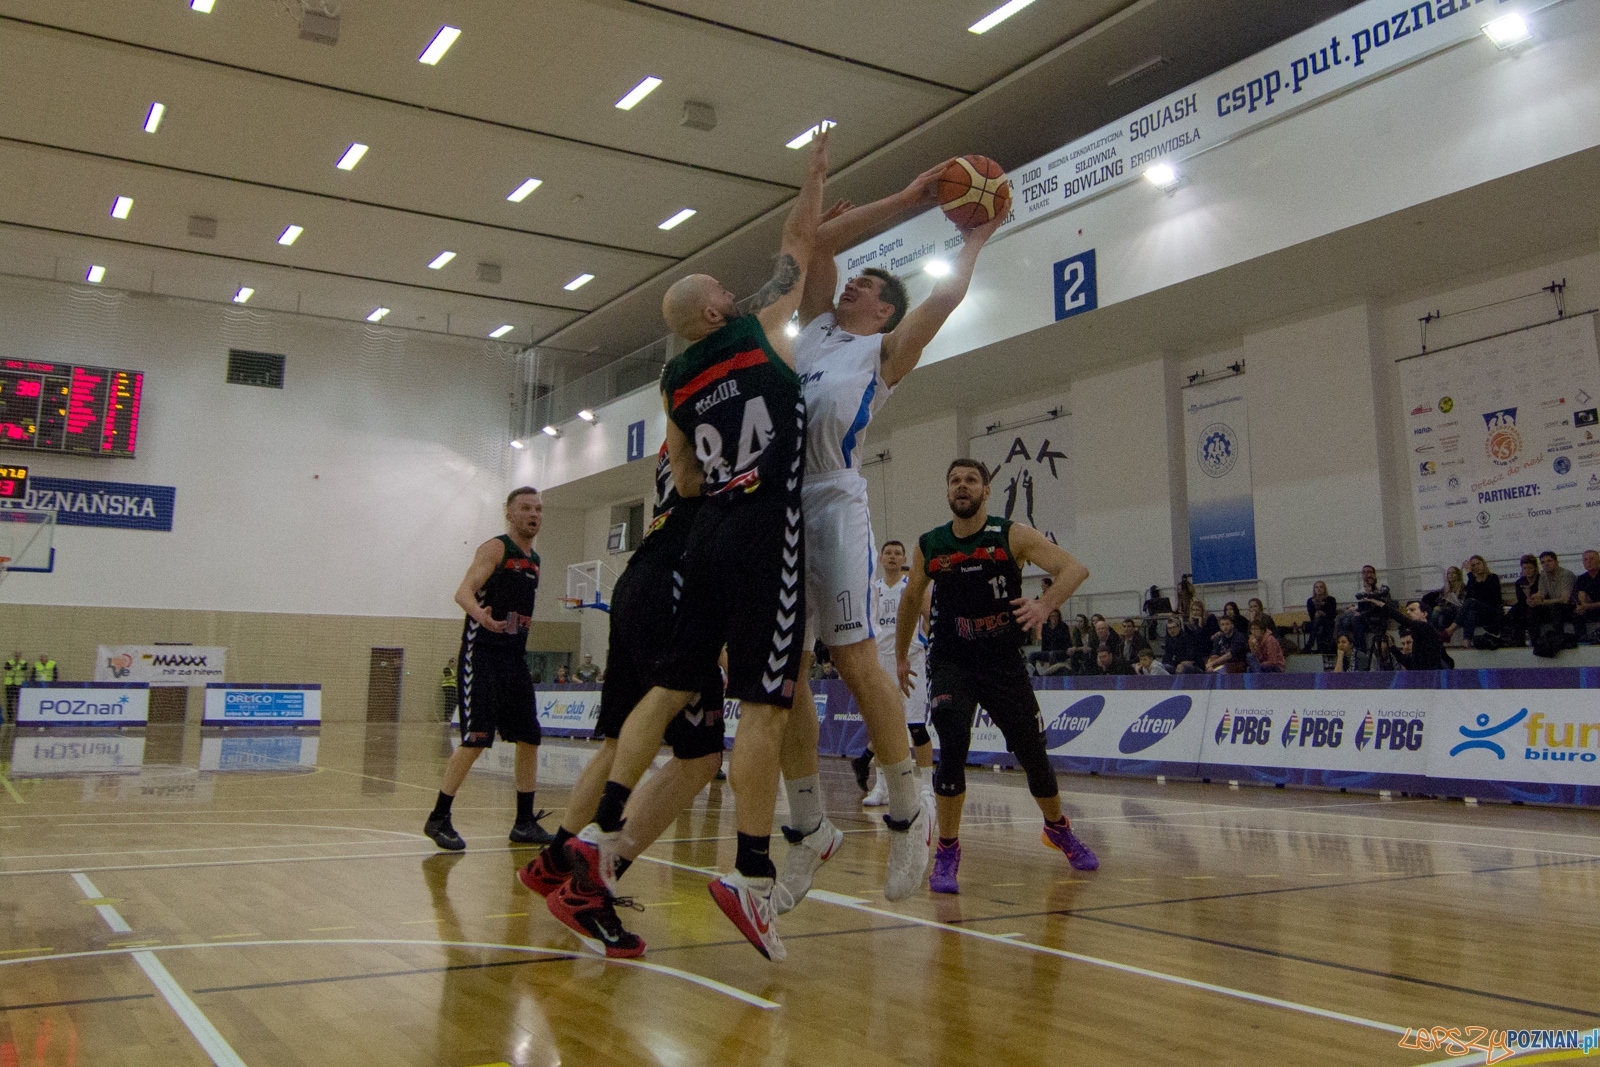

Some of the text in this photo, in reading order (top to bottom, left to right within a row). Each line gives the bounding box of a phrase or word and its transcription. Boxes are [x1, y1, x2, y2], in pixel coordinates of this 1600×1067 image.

[1129, 93, 1198, 142] SQUASH
[1075, 147, 1117, 174] SIŁOWNIA
[1130, 128, 1201, 169] ERGOWIOSŁA
[1021, 167, 1042, 185] JUDO
[1064, 159, 1124, 199] BOWLING
[1022, 175, 1058, 203] TENIS
[1028, 198, 1050, 213] KARATE
[847, 237, 904, 270] Centrum Sportu
[891, 240, 936, 270] Poznańskiej
[1064, 261, 1085, 311] 2
[15, 381, 41, 397] 38
[631, 426, 638, 456] 1
[1478, 483, 1541, 504] PARTNERZY:
[988, 575, 1008, 599] 12
[837, 590, 852, 622] 1
[883, 599, 896, 613] 11
[975, 612, 1009, 631] PEC
[40, 700, 123, 714] POZnan
[1234, 707, 1274, 717] fundacja
[1302, 708, 1346, 718] fundacja
[1377, 709, 1426, 719] fundacja
[1051, 713, 1090, 731] atrem
[1131, 715, 1176, 733] atrem
[1231, 716, 1272, 745] PBG
[1299, 717, 1344, 748] PBG
[1374, 719, 1424, 751] PBG
[1525, 748, 1597, 762] biuro
